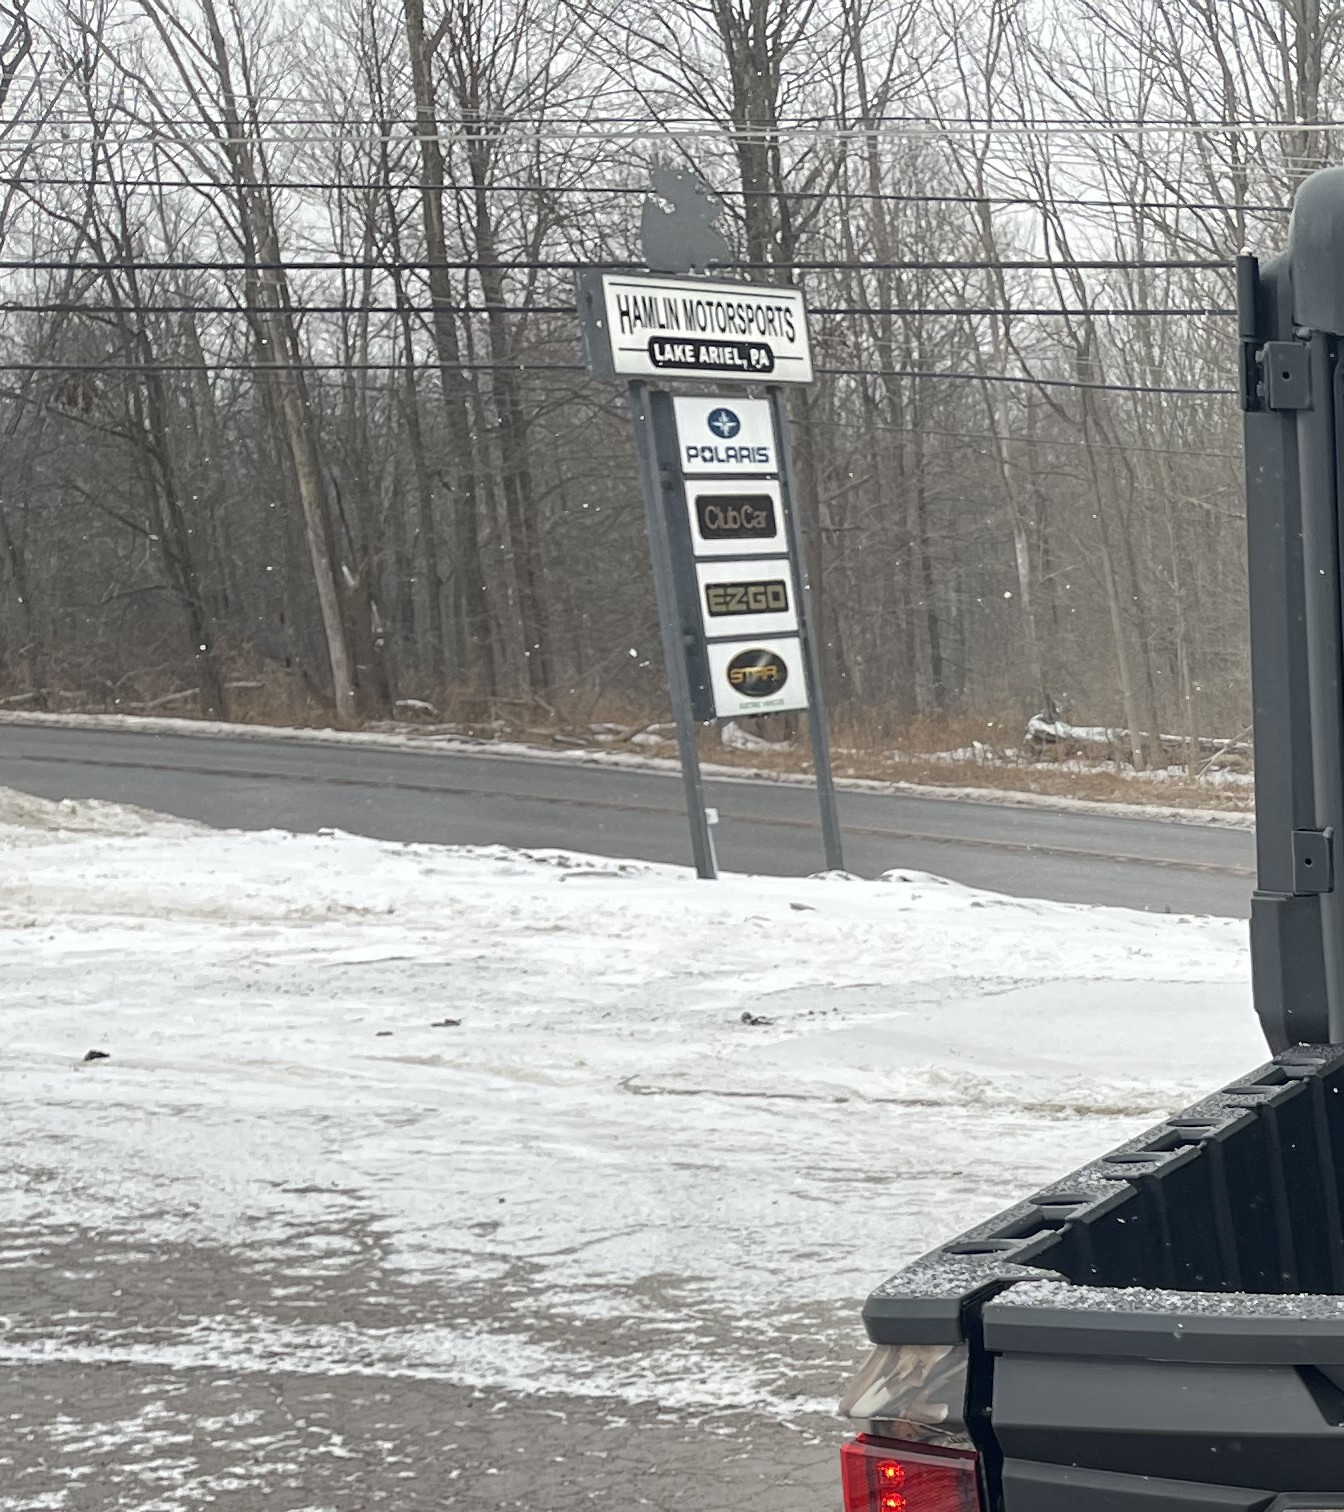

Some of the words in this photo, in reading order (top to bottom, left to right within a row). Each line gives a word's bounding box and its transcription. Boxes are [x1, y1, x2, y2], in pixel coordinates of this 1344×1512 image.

[616, 293, 681, 336] HAMLIN
[681, 297, 796, 344] MOTORSPORTS
[653, 343, 696, 363] LAKE
[698, 347, 749, 370] ARIEL,
[750, 348, 770, 369] PA
[685, 445, 770, 464] POLARIS
